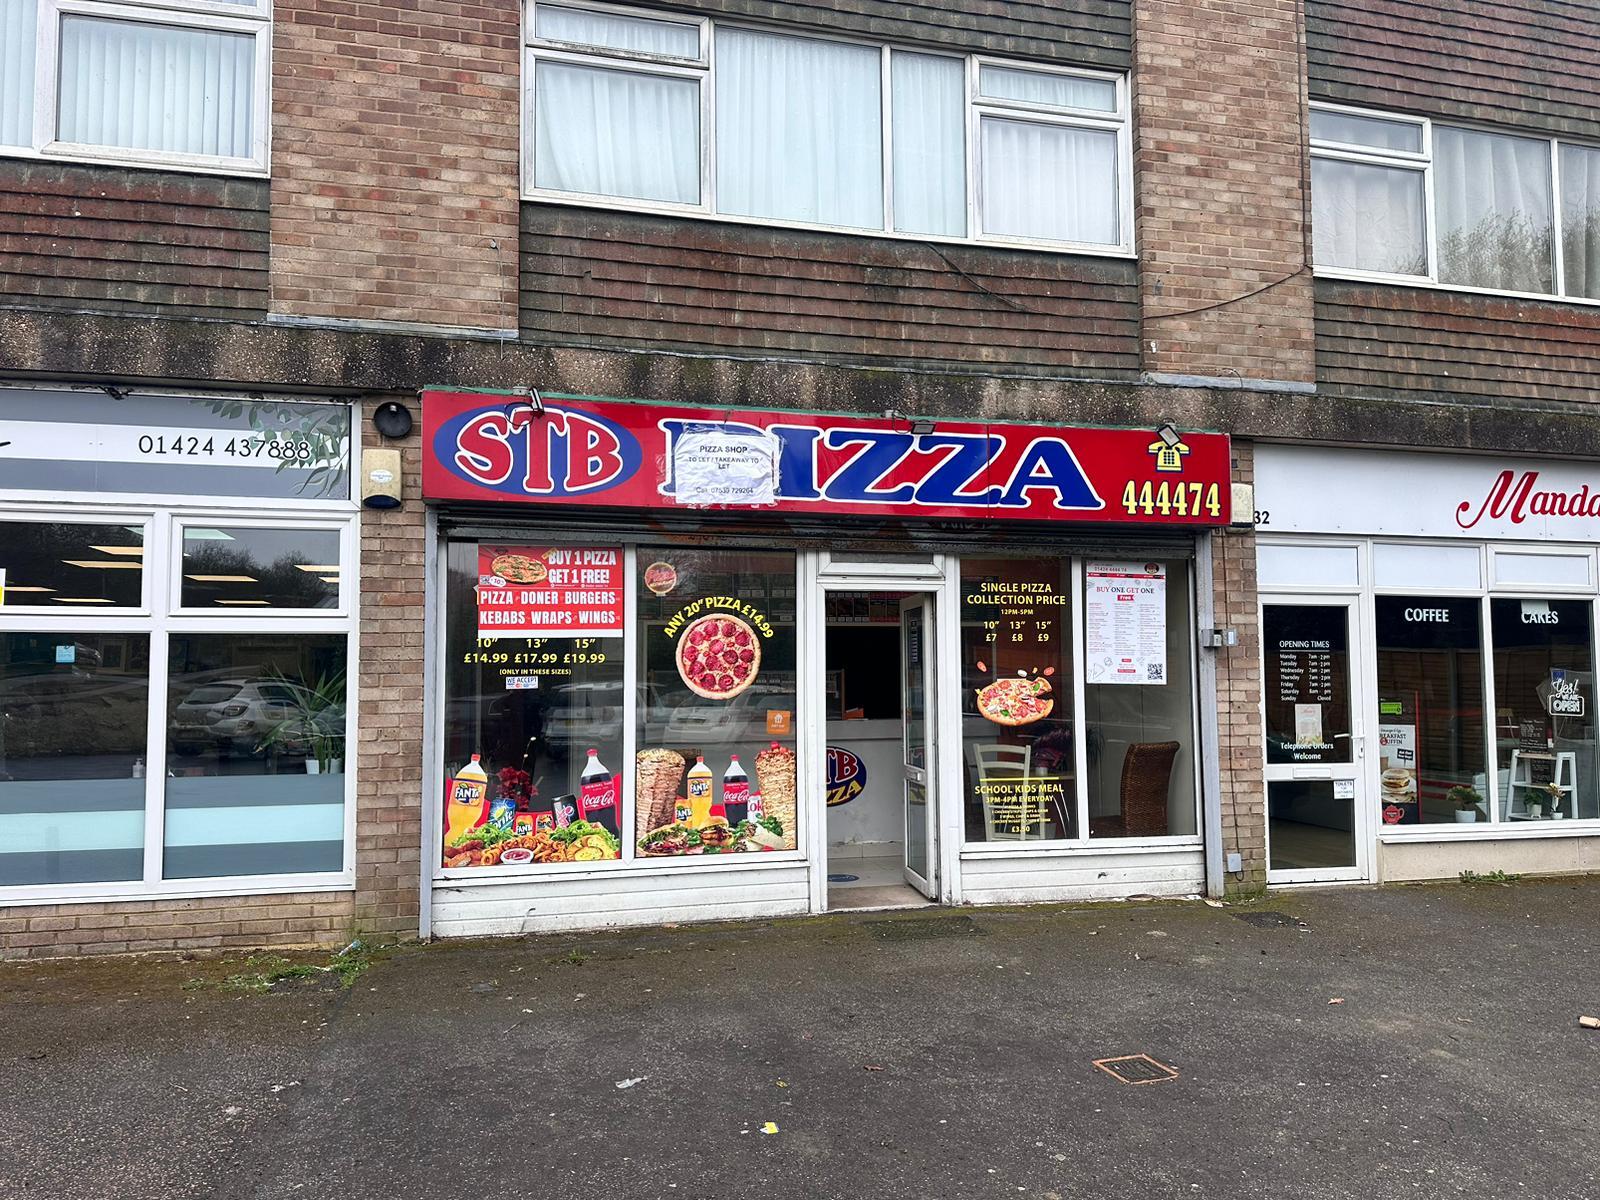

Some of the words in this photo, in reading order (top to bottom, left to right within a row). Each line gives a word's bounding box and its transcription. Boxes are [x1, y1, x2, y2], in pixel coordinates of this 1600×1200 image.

[138, 435, 214, 456] 01424
[224, 437, 311, 459] 437888
[454, 406, 623, 492] STB
[725, 446, 748, 454] SHOP
[1122, 480, 1221, 517] 444474
[1254, 510, 1270, 525] 32
[548, 550, 572, 566] BUY
[574, 551, 582, 565] 1
[584, 550, 616, 566] PIZZA
[548, 569, 569, 584] GET
[571, 569, 579, 584] 1
[581, 569, 610, 584] FREE!
[980, 582, 1018, 593] SINGLE
[1021, 583, 1052, 593] PIZZA
[480, 591, 514, 605] PIZZA
[520, 591, 559, 605] DONER
[564, 591, 616, 605] BURGERS
[966, 594, 1033, 605] COLLECTION
[1036, 595, 1066, 605] PRICE
[480, 610, 525, 625] KEBABS
[531, 610, 572, 625] WRAPS
[579, 610, 616, 625] WINGS
[664, 611, 686, 639] ANY
[705, 596, 741, 611] PIZZA
[740, 604, 775, 639] £14.99
[1404, 608, 1449, 623] COFFEE
[1521, 610, 1559, 624] CAKES
[985, 633, 997, 642] £7
[1011, 633, 1023, 642] £8
[1037, 633, 1050, 642] £9
[1279, 640, 1310, 648] OPENING
[1310, 640, 1330, 648] TIMES
[463, 652, 509, 664] £14.99
[514, 652, 558, 664] £17.99
[563, 652, 606, 664] £19.99
[499, 668, 520, 676] (ONLY
[551, 668, 572, 676] SIZES)
[517, 676, 537, 684] ACCEPT
[1552, 678, 1580, 699] Yes!
[1552, 699, 1580, 712] OPEN
[1293, 752, 1322, 760] Welcome
[826, 747, 859, 784] TB
[455, 787, 480, 799] FANTA
[974, 785, 1013, 795] SCHOOL
[1014, 784, 1037, 794] KIDS
[1038, 783, 1065, 793] MEAL
[1018, 794, 1055, 803] EVERYDAY
